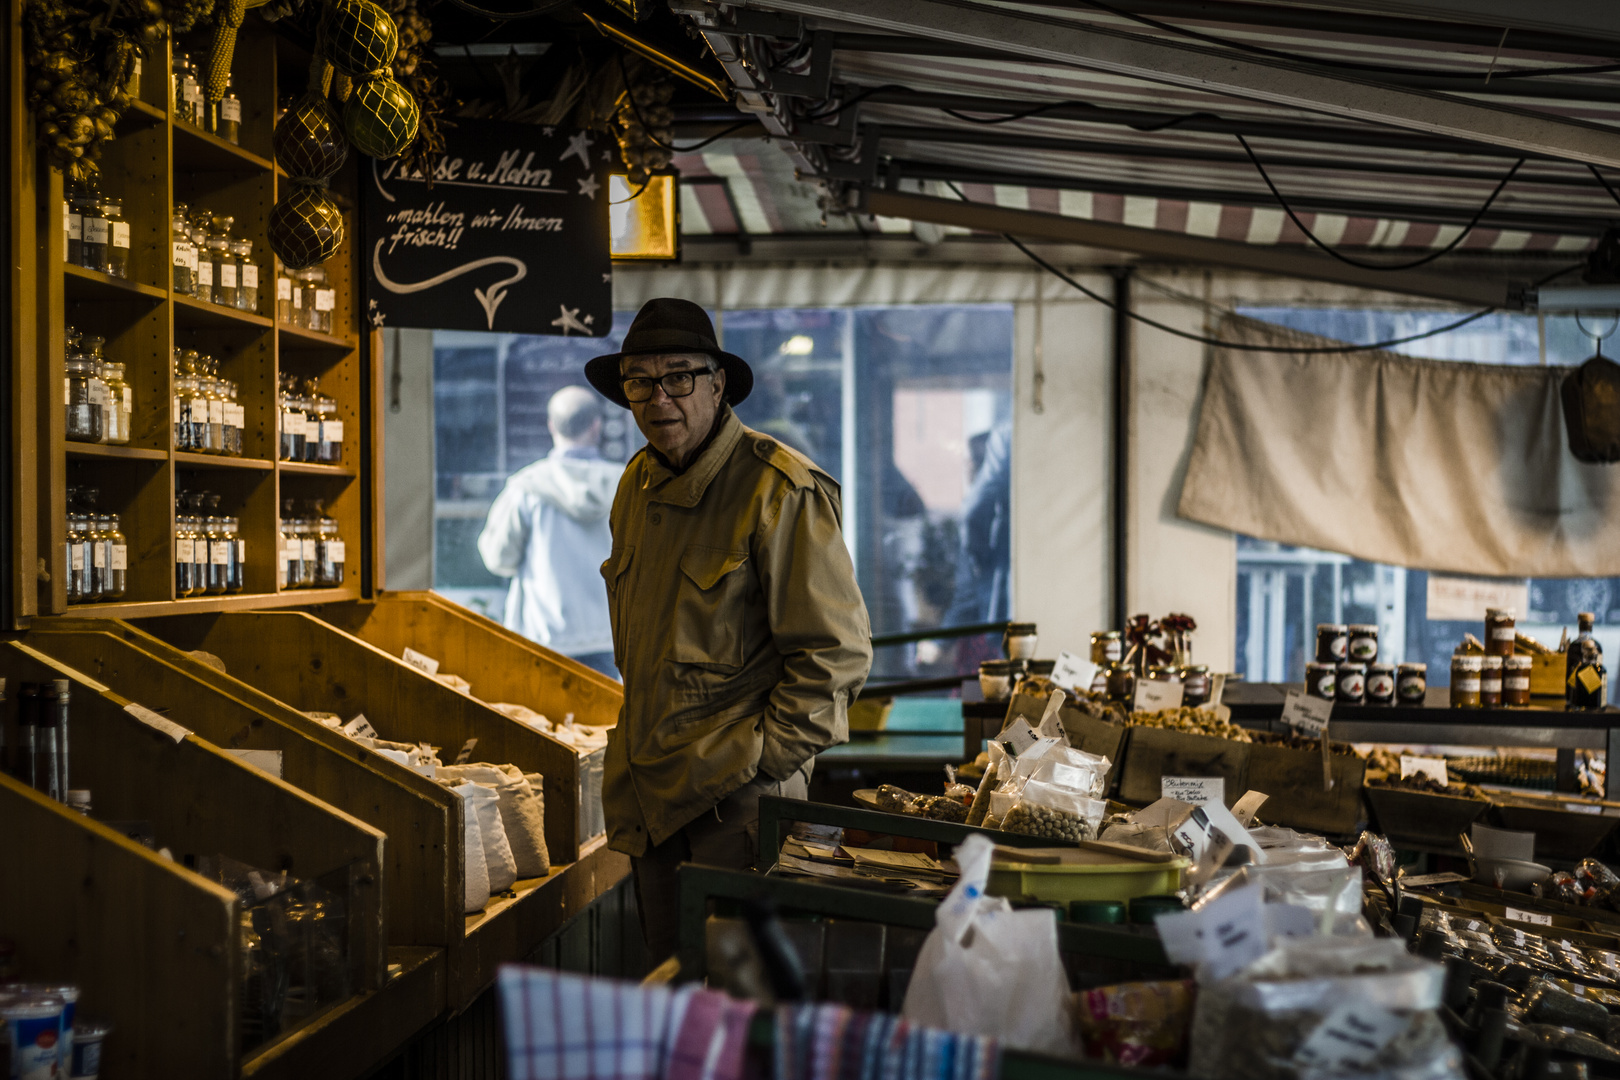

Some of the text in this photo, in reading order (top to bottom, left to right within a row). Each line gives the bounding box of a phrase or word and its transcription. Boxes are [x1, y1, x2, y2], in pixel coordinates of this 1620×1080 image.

[471, 208, 503, 229] wir
[501, 202, 563, 232] Ihnen
[388, 223, 465, 255] frisch!!
